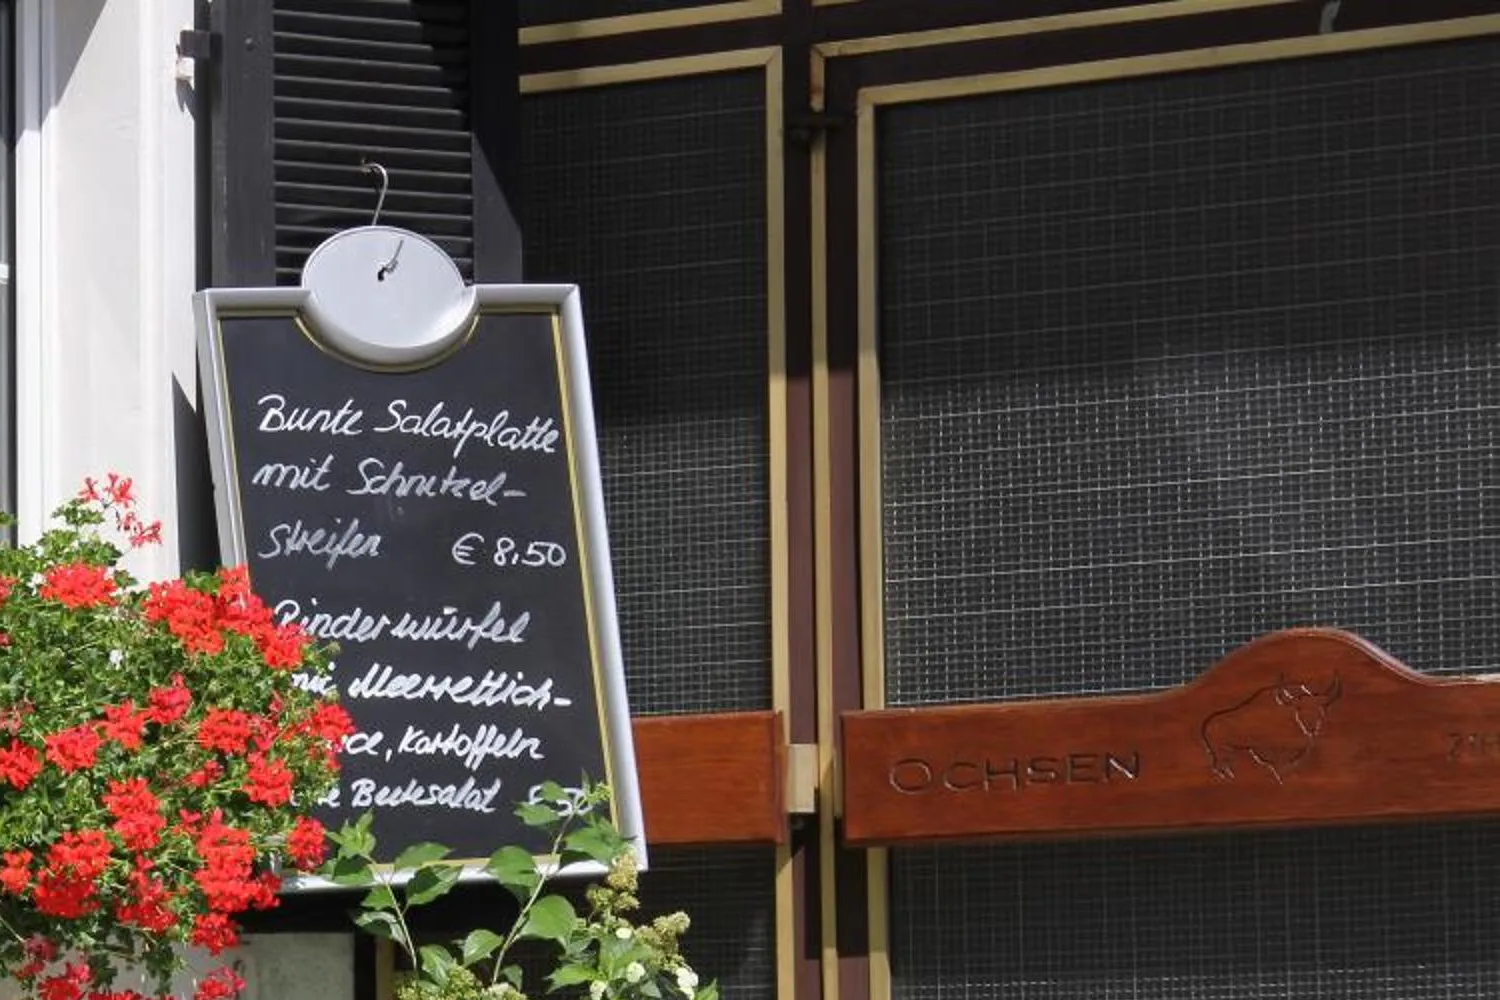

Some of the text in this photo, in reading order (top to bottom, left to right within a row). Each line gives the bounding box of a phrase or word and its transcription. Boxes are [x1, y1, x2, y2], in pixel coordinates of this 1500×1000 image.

[257, 394, 556, 458] Bunte Salatplatte
[251, 453, 527, 506] mit Schnitzel-
[451, 532, 485, 566] €
[493, 536, 567, 567] 8,50
[397, 722, 545, 771] Kartoffeln
[888, 751, 1141, 795] OCHSEN
